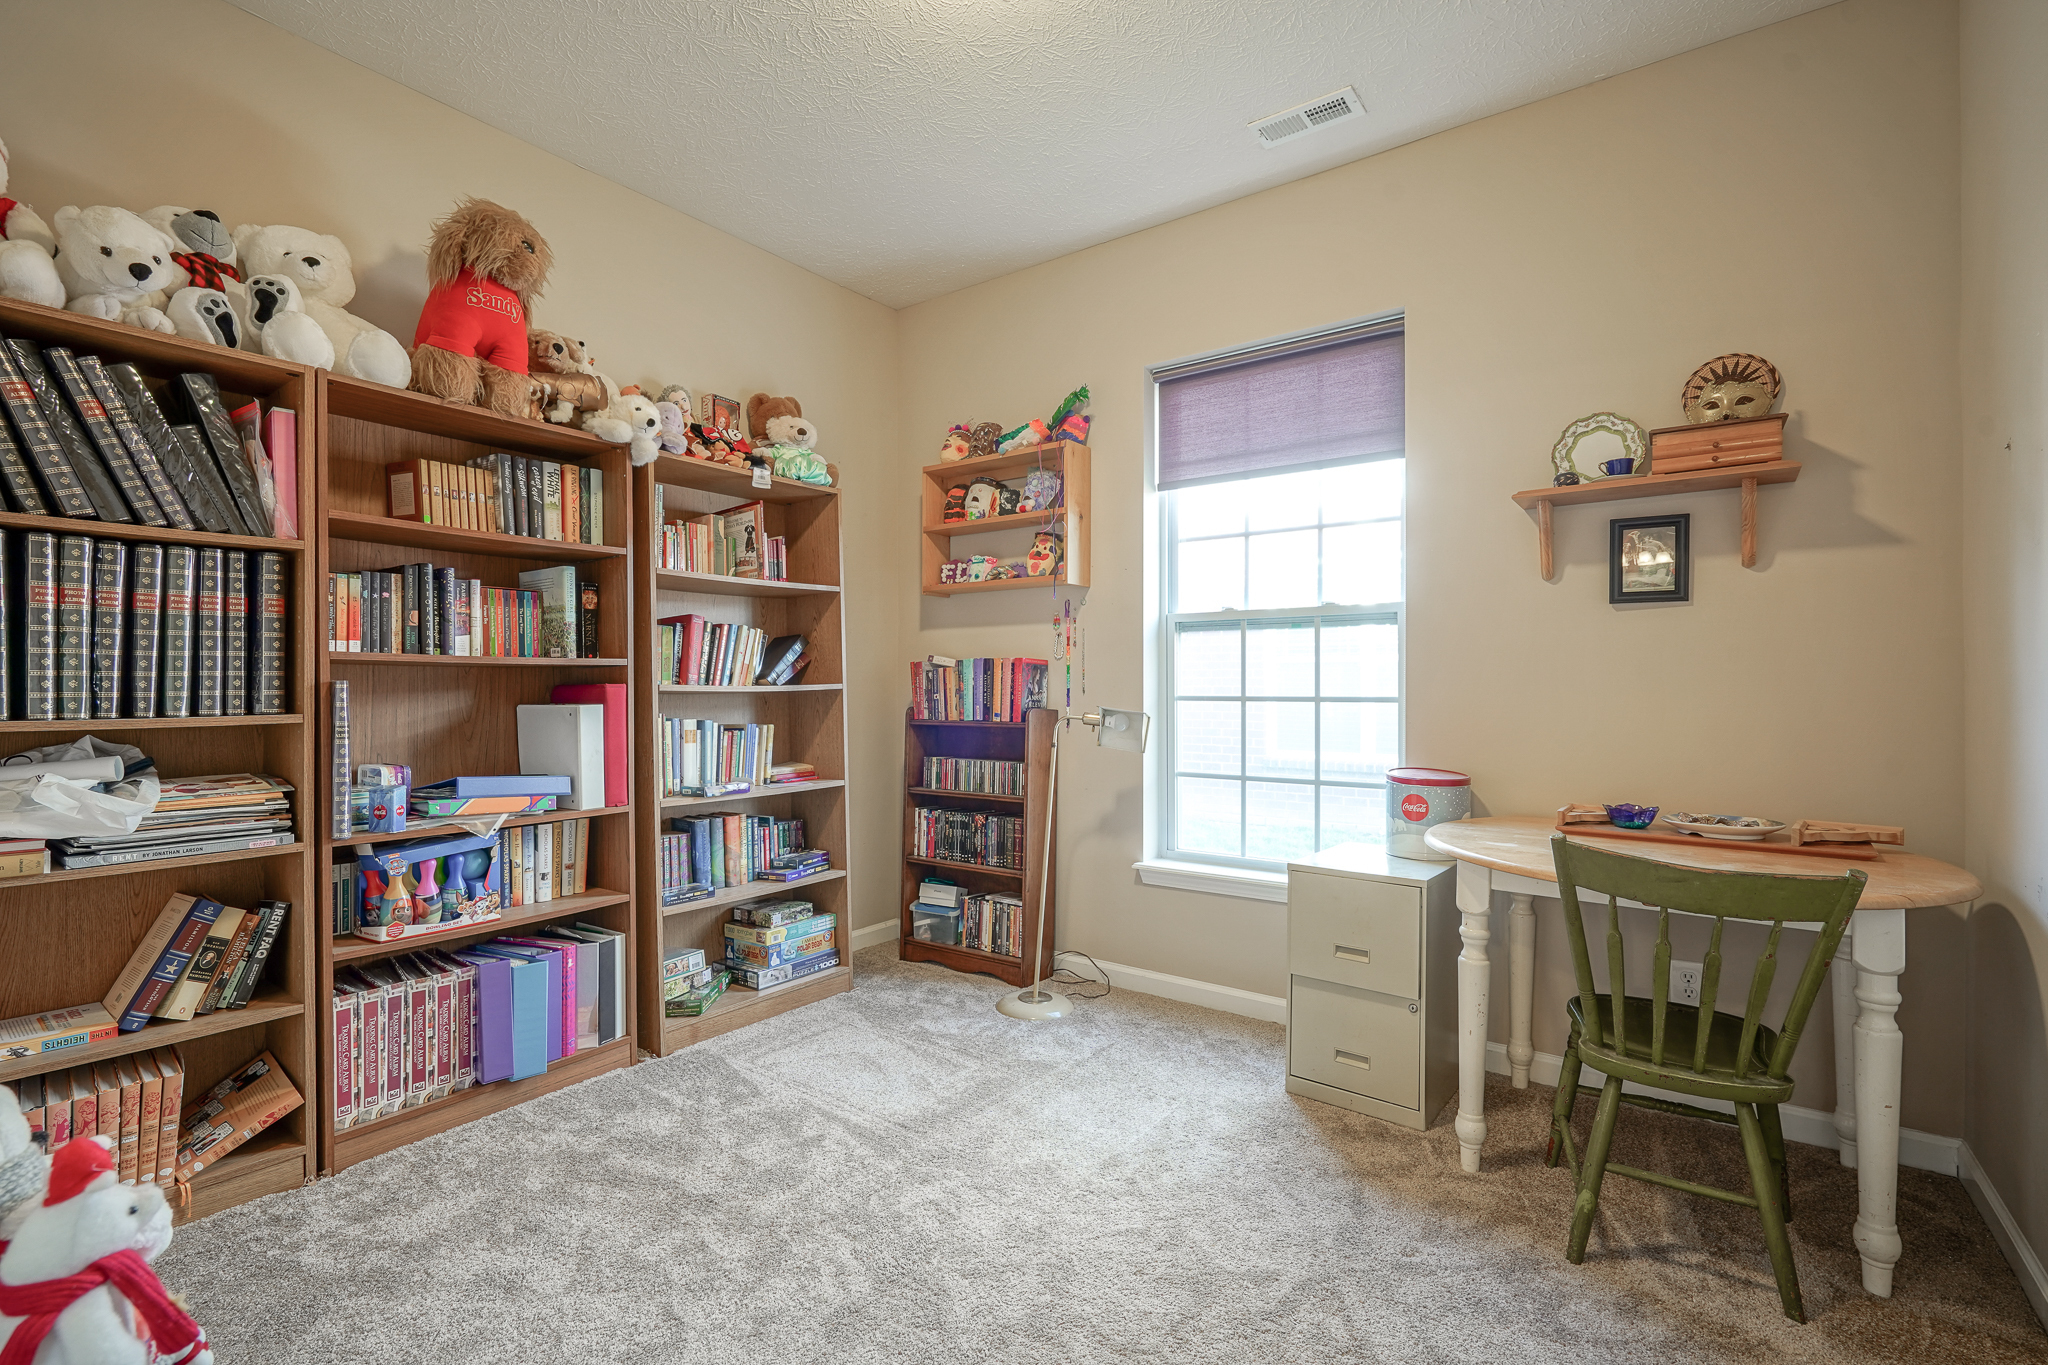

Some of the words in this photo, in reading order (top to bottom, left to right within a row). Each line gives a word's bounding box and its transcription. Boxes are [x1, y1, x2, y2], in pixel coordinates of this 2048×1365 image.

[466, 287, 522, 323] Sandy
[112, 854, 138, 862] RENT
[268, 909, 285, 936] RENT
[425, 922, 451, 931] BOWLING
[182, 923, 202, 951] HAMILTON
[796, 943, 811, 953] POLAR
[811, 940, 823, 950] BEAR
[255, 936, 273, 959] FAQ
[792, 966, 814, 978] PUZZLE
[818, 958, 839, 969] 1000
[142, 982, 163, 1012] REVOLUTION
[44, 1035, 85, 1050] HEIGHTS
[91, 1031, 104, 1039] THE
